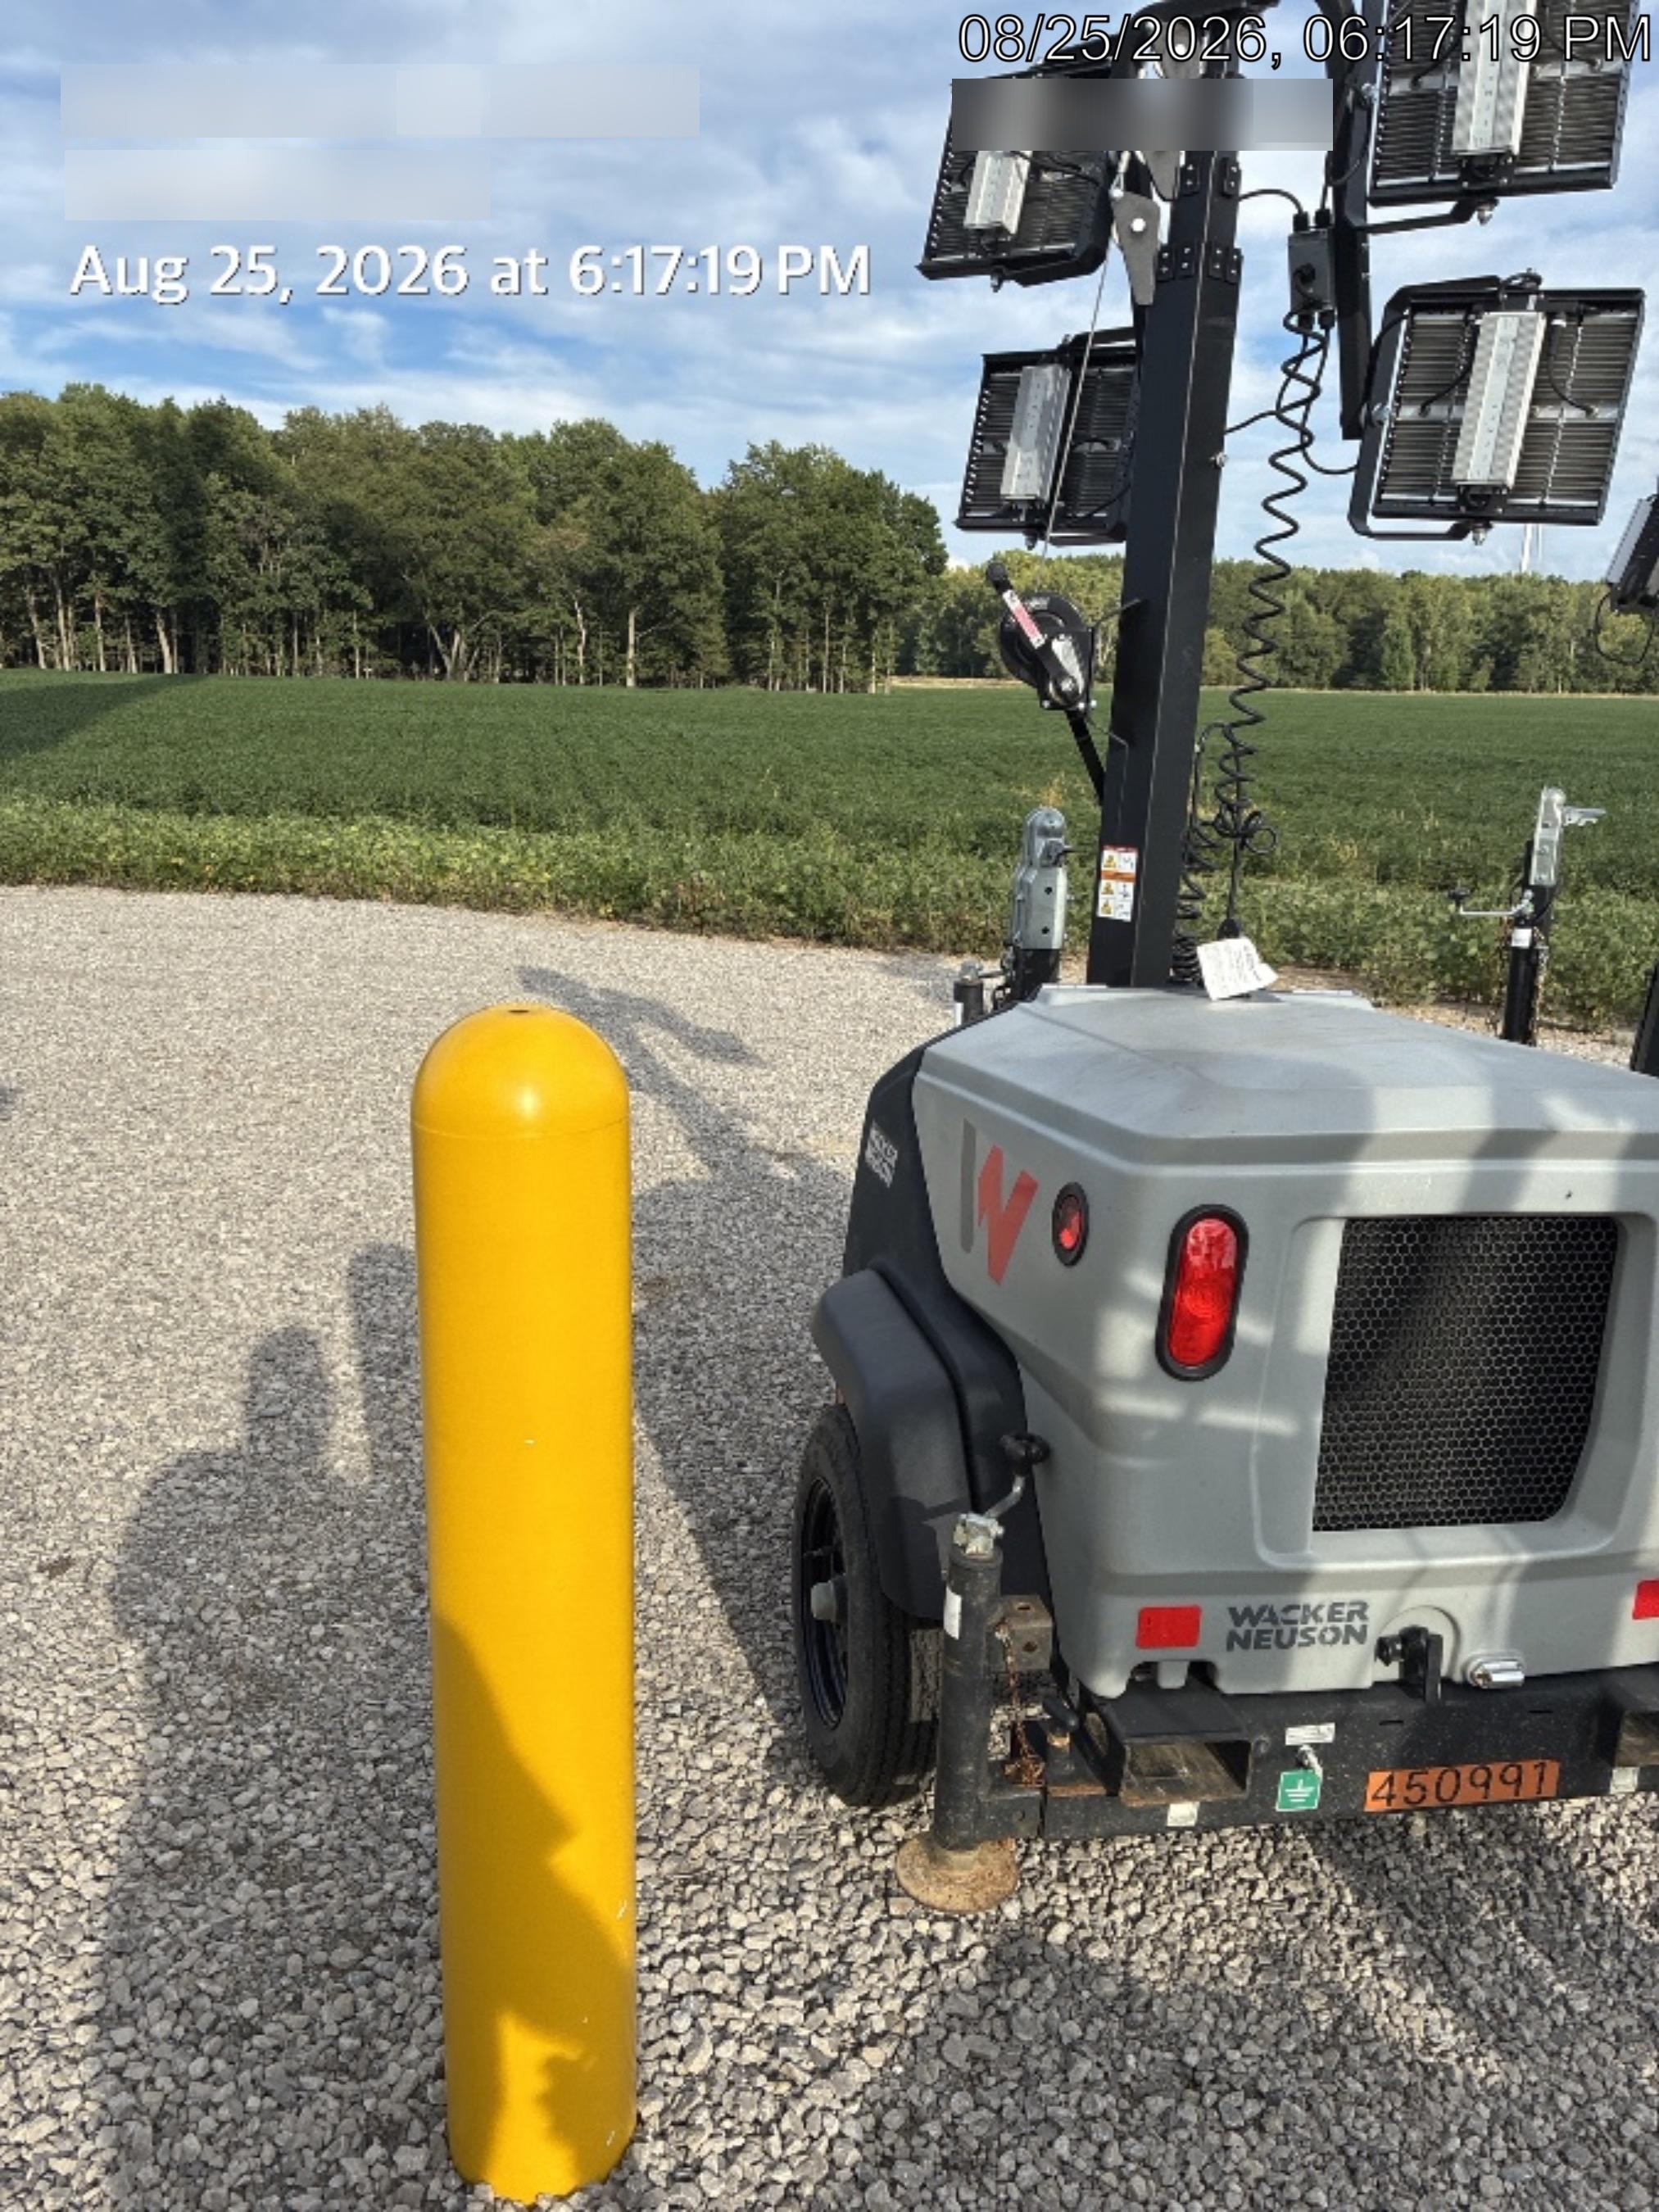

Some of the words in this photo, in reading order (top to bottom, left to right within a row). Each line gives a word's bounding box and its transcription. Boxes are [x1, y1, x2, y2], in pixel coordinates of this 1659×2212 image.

[1226, 1600, 1369, 1628] WACKER
[1226, 1624, 1368, 1652] NEUSON
[1371, 1761, 1548, 1807] 450991
